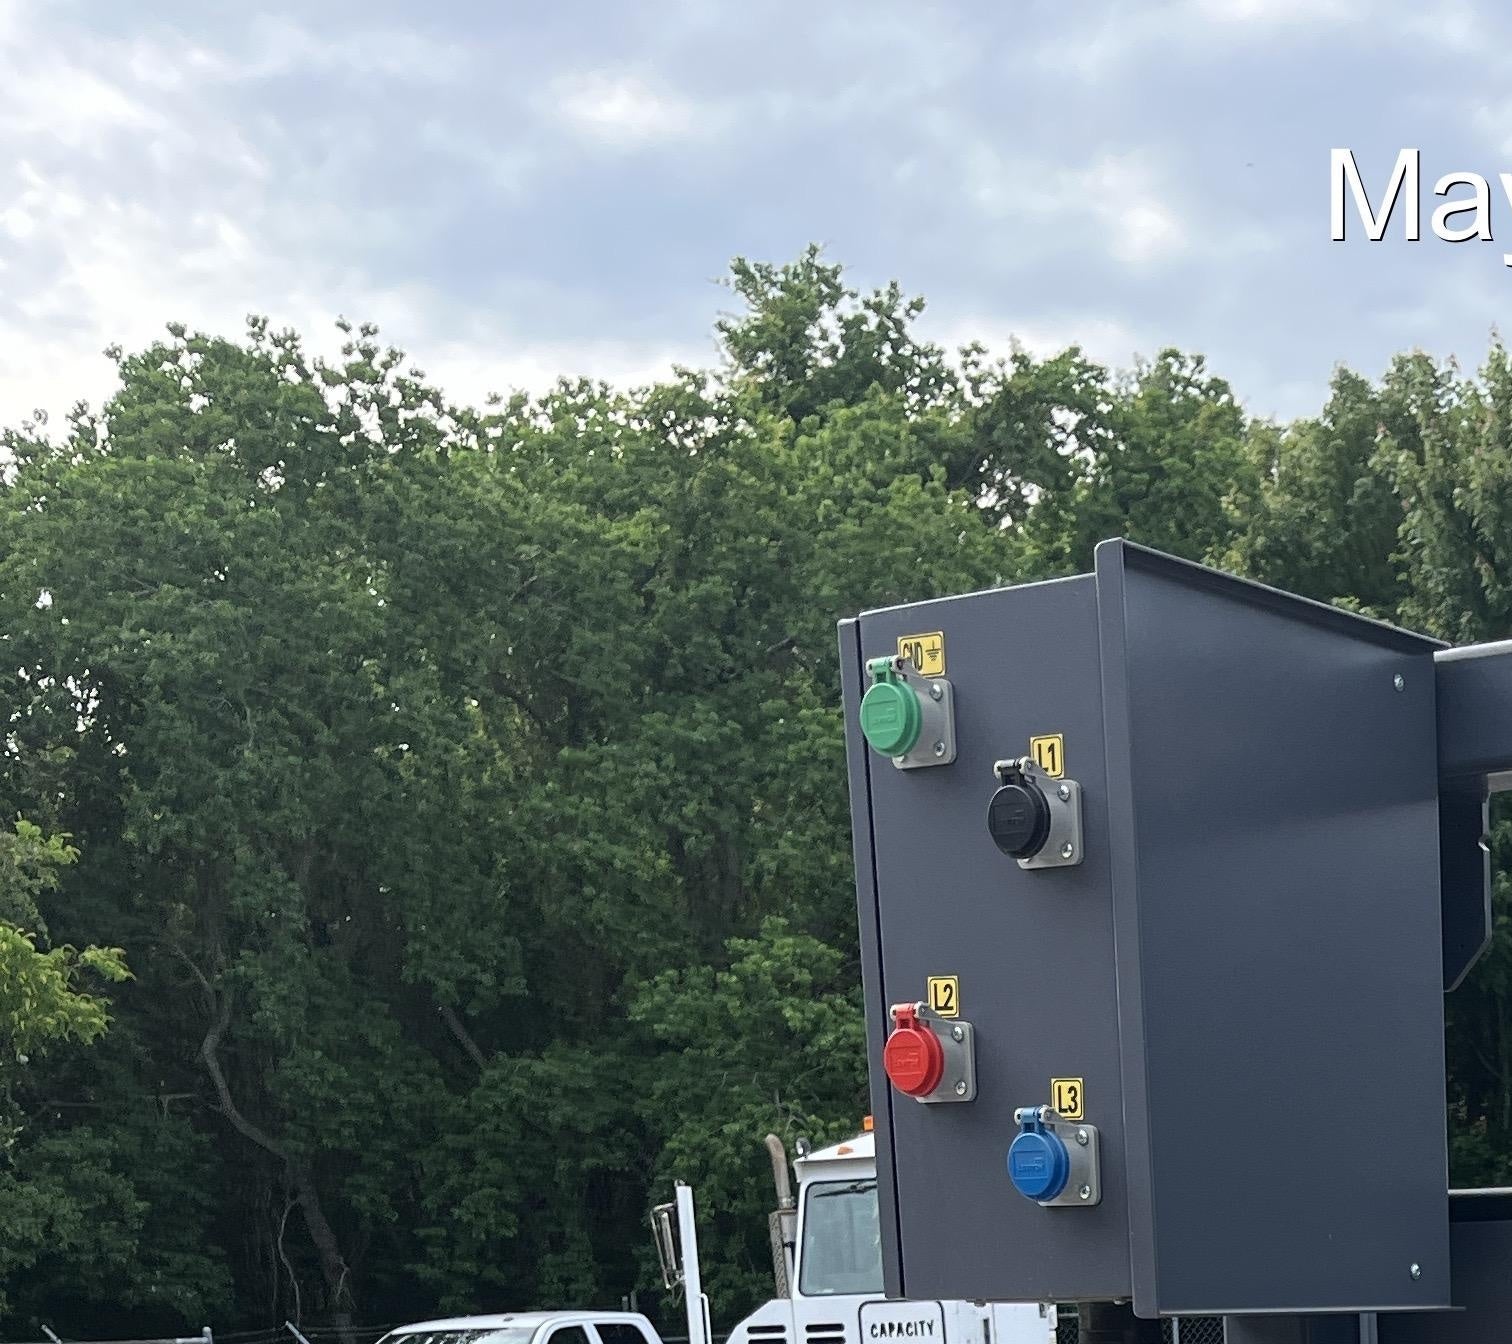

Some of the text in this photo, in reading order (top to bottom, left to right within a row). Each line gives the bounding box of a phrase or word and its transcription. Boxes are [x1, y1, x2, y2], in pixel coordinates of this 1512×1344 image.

[1037, 743, 1056, 773] L1
[933, 983, 954, 1011] L2
[1058, 1085, 1078, 1114] L3
[870, 1320, 934, 1338] CAPACITY
